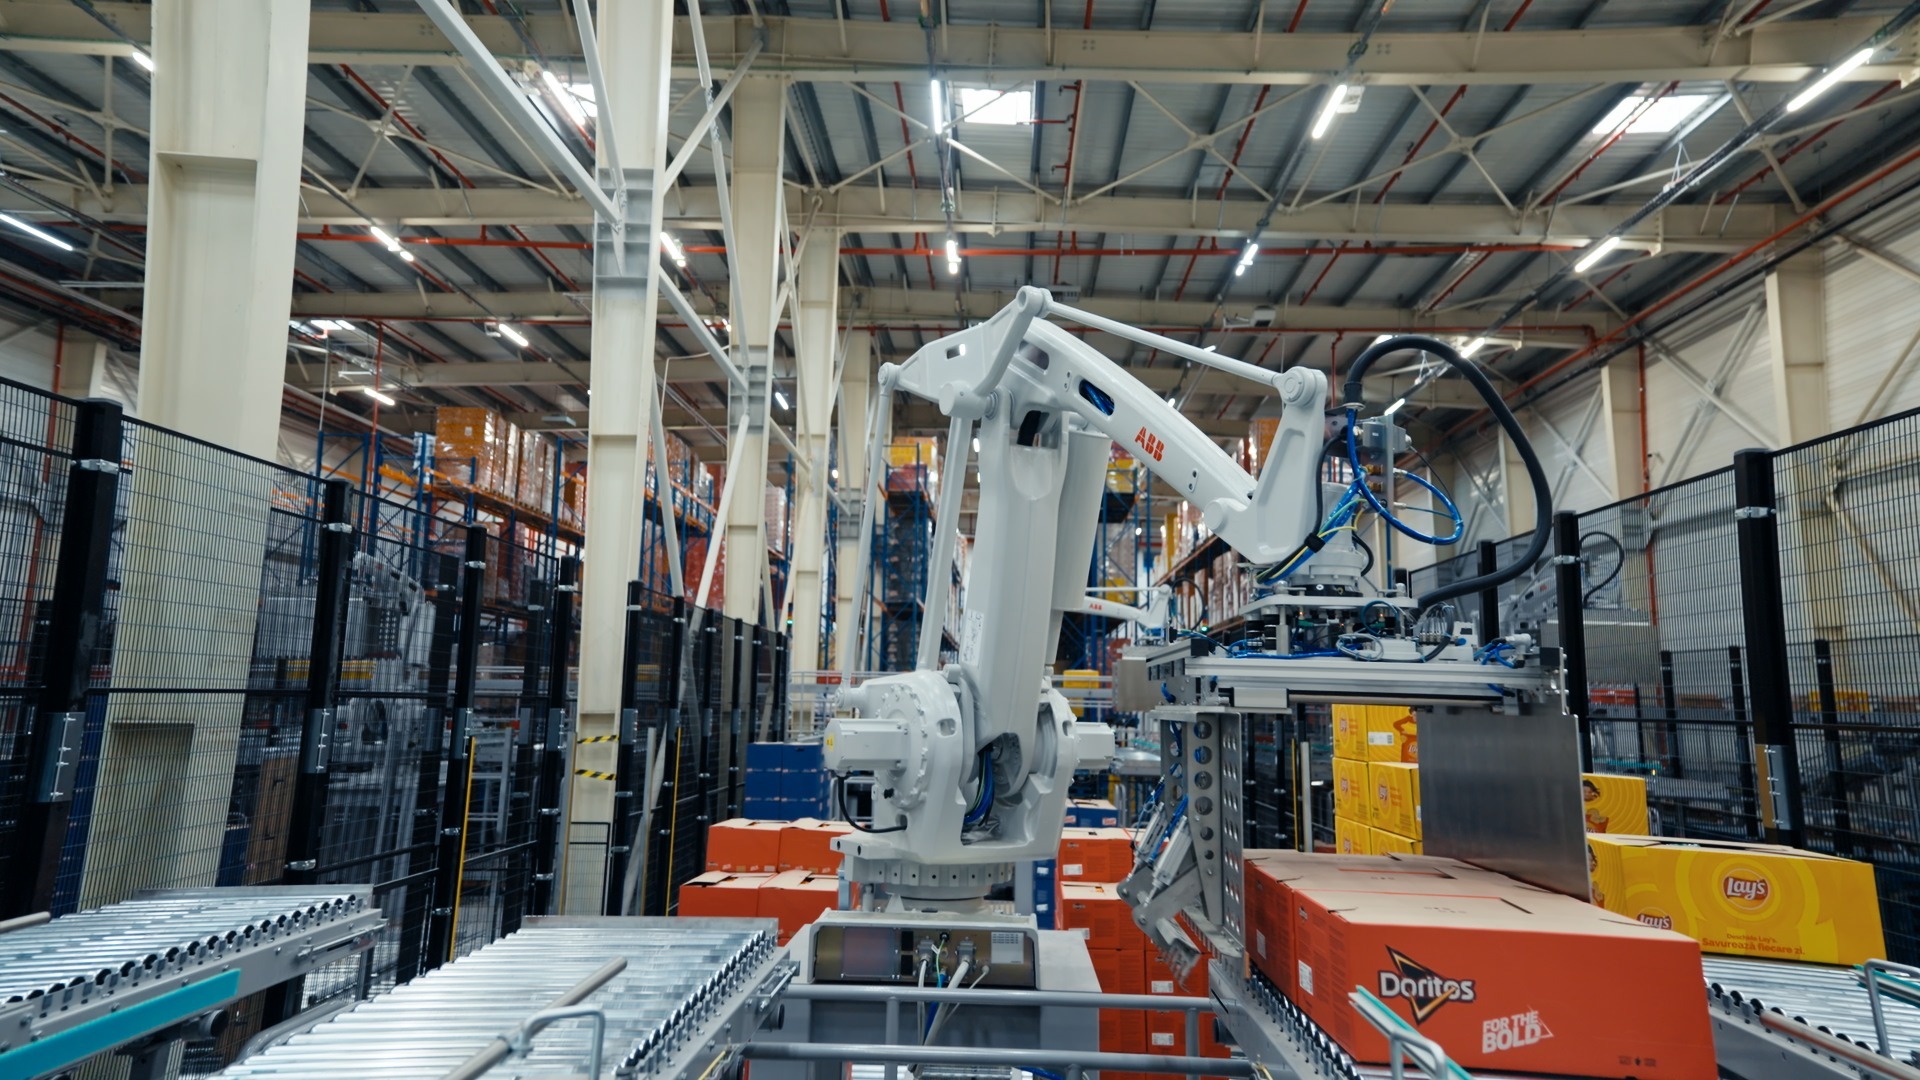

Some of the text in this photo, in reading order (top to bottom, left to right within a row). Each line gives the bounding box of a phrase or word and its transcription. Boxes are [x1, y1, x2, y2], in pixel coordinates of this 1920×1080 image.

[1134, 426, 1165, 462] ABB
[1726, 877, 1767, 900] Lay's
[1758, 942, 1793, 953] fiecare
[1379, 970, 1476, 1002] Doritos
[1482, 1010, 1539, 1034] FOR THE
[1482, 1022, 1542, 1054] BOLD
